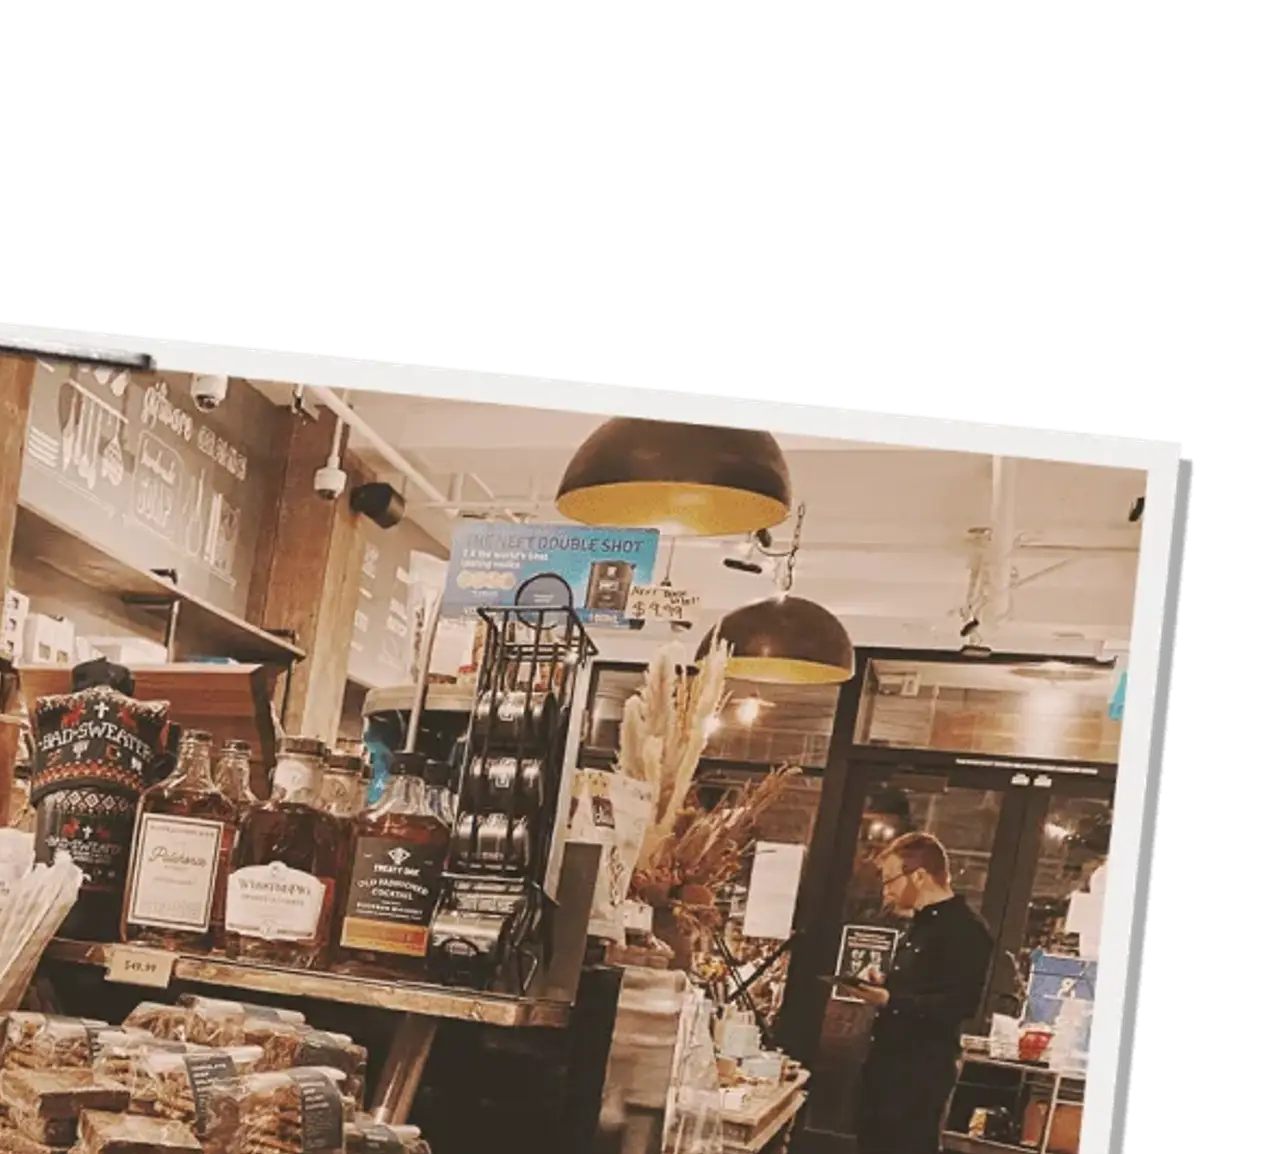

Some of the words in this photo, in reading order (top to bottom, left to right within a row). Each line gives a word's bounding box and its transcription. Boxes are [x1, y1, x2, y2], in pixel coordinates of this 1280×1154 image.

[500, 535, 535, 550] NEFT
[539, 536, 597, 553] DOUBLE
[600, 539, 644, 554] SHOT
